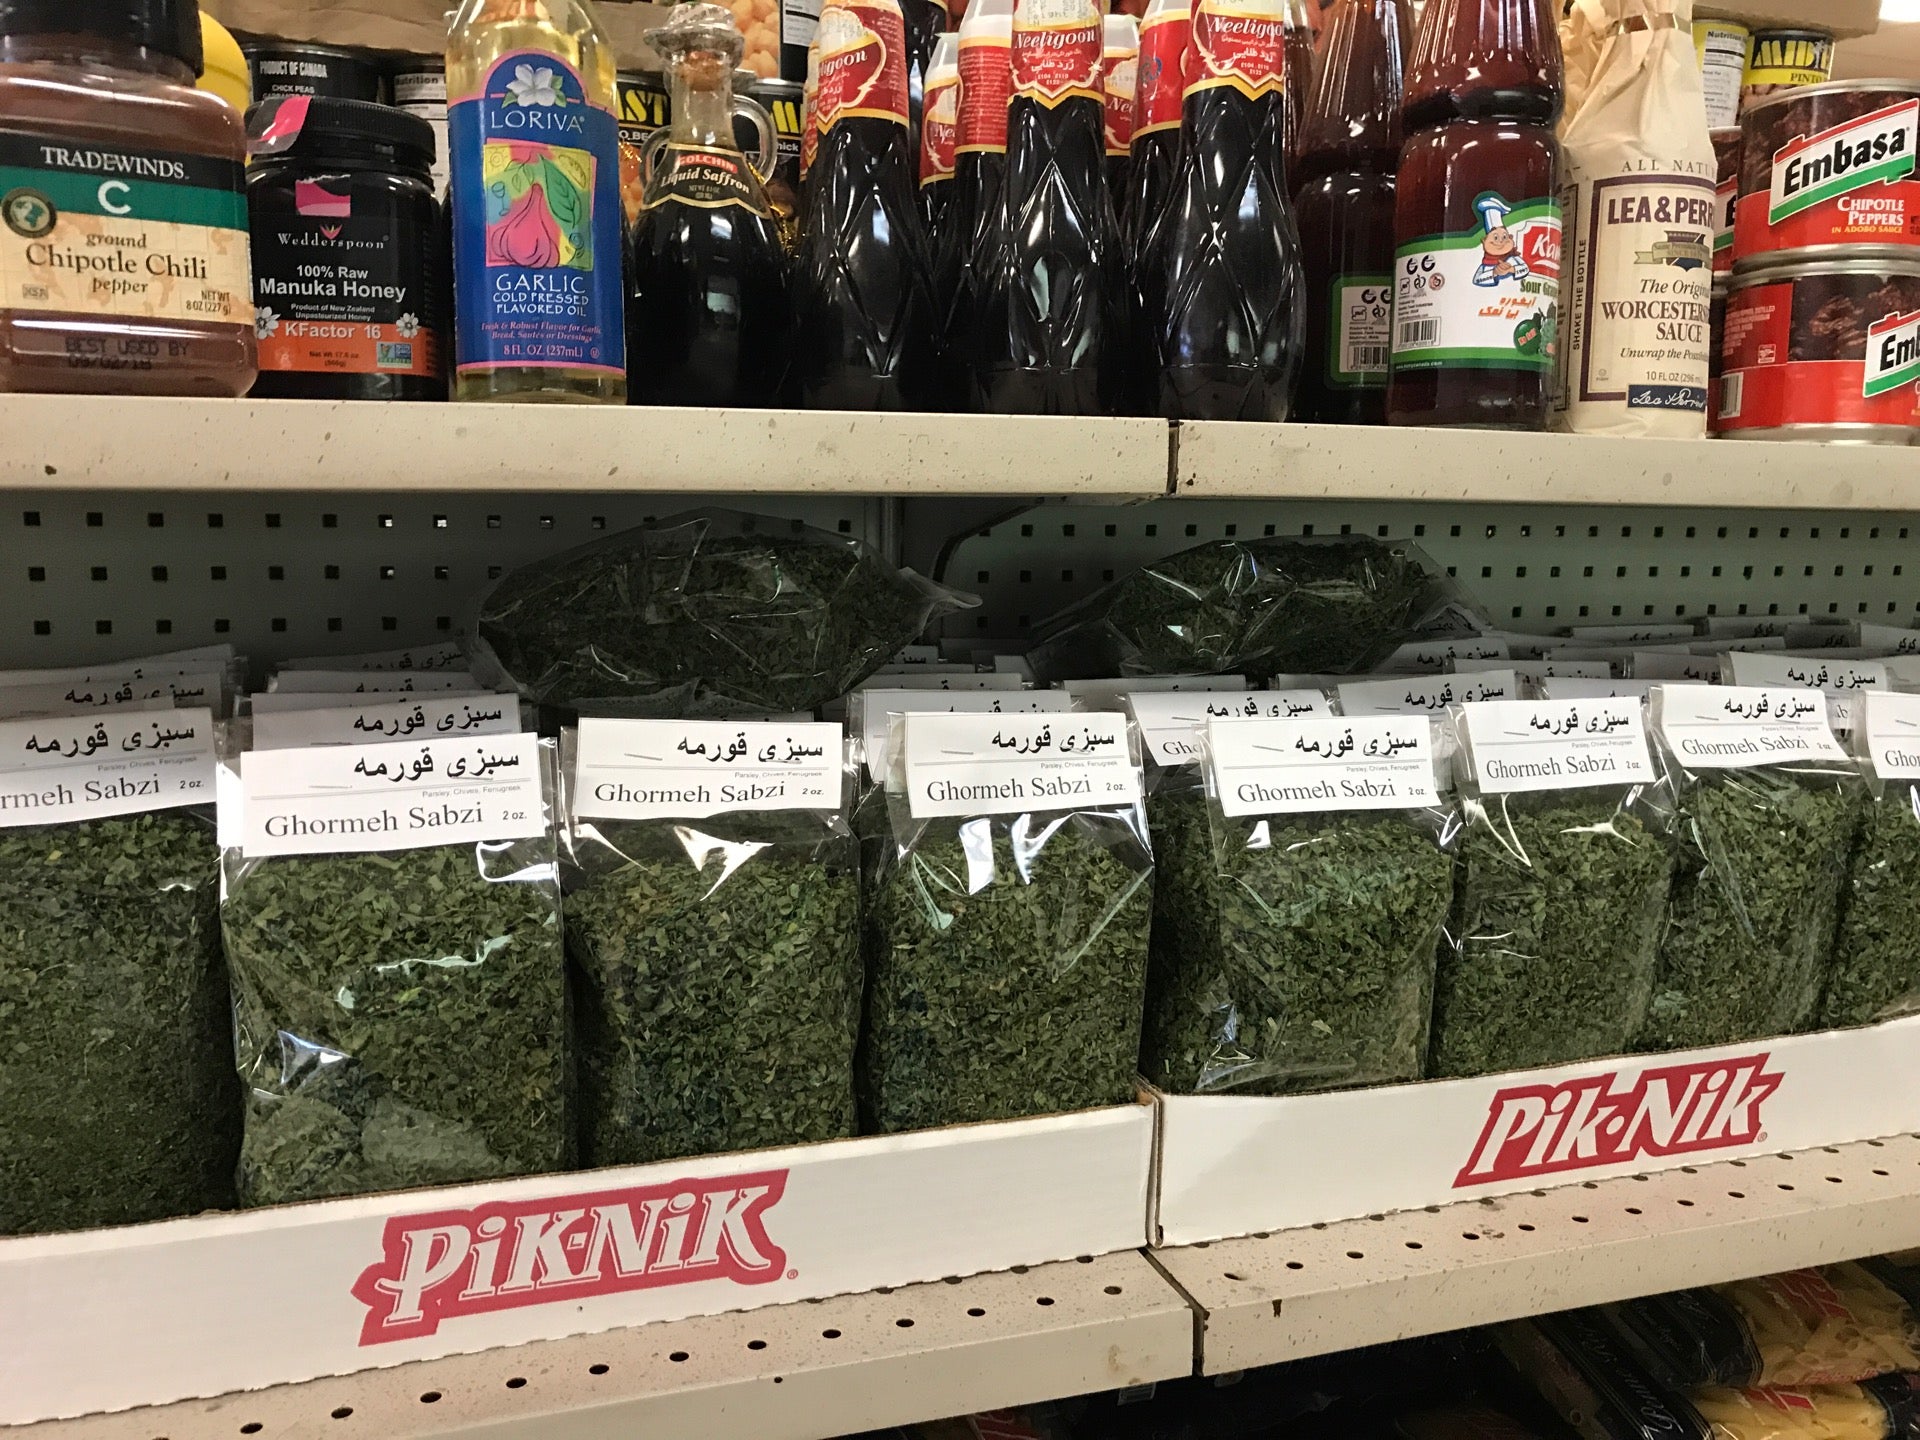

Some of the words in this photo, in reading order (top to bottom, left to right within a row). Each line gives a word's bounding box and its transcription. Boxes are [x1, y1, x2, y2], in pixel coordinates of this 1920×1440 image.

[1210, 17, 1284, 38] Neeligoo
[260, 61, 287, 75] PRODUCT
[289, 62, 298, 75] OF
[300, 62, 328, 78] CANADA
[491, 110, 582, 134] LORIVA
[40, 146, 185, 180] TRADEWINDS
[1622, 159, 1660, 172] ALL
[1783, 128, 1906, 197] Embasa
[661, 167, 700, 187] Liquid
[703, 169, 751, 193] Saffron
[98, 180, 131, 215] C
[1837, 197, 1904, 211] CHIPOTLE
[1848, 210, 1904, 226] PEPPERS
[86, 234, 147, 249] ground
[278, 232, 384, 250] Wedderspoon
[26, 243, 137, 274] Chipotle
[146, 254, 208, 279] Chili
[297, 265, 334, 278] 100%
[338, 266, 368, 279] Raw
[1577, 239, 1587, 285] BOTTLE
[92, 277, 149, 293] pepper
[201, 290, 216, 300] NET
[260, 278, 337, 296] Manuka
[343, 281, 406, 303] Honey
[496, 273, 585, 294] GARLIC
[1520, 279, 1541, 294] Sour
[1640, 279, 1668, 293] The
[186, 300, 192, 310] 8
[493, 293, 526, 303] COLD
[531, 293, 589, 305] PRESSED
[1575, 286, 1584, 309] THE
[497, 304, 564, 314] FLAVORED
[567, 306, 587, 317] OIL
[285, 322, 355, 338] KFactor
[364, 325, 381, 339] 16
[1573, 310, 1583, 350] SHAKE
[1656, 322, 1702, 343] SAUCE
[65, 337, 105, 353] BEST
[118, 340, 159, 356] USED
[168, 341, 189, 356] BY
[504, 345, 510, 355] 8
[1620, 348, 1665, 360] Unwrap
[1667, 348, 1681, 359] the
[1646, 371, 1657, 381] 10
[1659, 372, 1667, 381] FL
[1668, 372, 1680, 381] OZ
[1788, 665, 1828, 687] قورمه
[1834, 664, 1876, 689] سبزی
[1405, 683, 1453, 709] قورمه
[1724, 693, 1768, 719] قورمه
[1775, 697, 1815, 718] سبزی
[353, 705, 425, 735] قورمه
[436, 704, 502, 732] سبزی
[1530, 707, 1579, 735] قورمه
[1586, 710, 1629, 733] سبزی
[26, 722, 108, 757] قورمه
[122, 723, 195, 751] سبزی
[677, 732, 747, 762] قورمه
[992, 724, 1051, 754] قورمه
[1060, 728, 1114, 752] سبزی
[1294, 728, 1354, 758] قورمه
[1363, 731, 1417, 756] سبزی
[1681, 738, 1759, 755] Ghormeh
[1760, 735, 1810, 751] Sabzi
[758, 737, 823, 763] سبزی
[354, 747, 434, 781] قورمه
[447, 748, 519, 777] سبزی
[1486, 756, 1562, 779] Ghormeh
[1566, 753, 1616, 774] Sabzi
[84, 774, 160, 802] Sabzi
[180, 780, 186, 789] 2
[595, 783, 710, 803] Ghormeh
[721, 781, 785, 803] Sabzi
[927, 778, 1024, 801] Ghormeh
[1031, 774, 1091, 797] Sabzi
[1237, 780, 1337, 803] Ghormeh
[1341, 778, 1396, 797] Sabzi
[1408, 787, 1414, 795] 2
[264, 809, 398, 838] Ghormeh
[408, 801, 483, 829] Sabzi
[502, 810, 509, 820] 2
[511, 811, 527, 820] oz.
